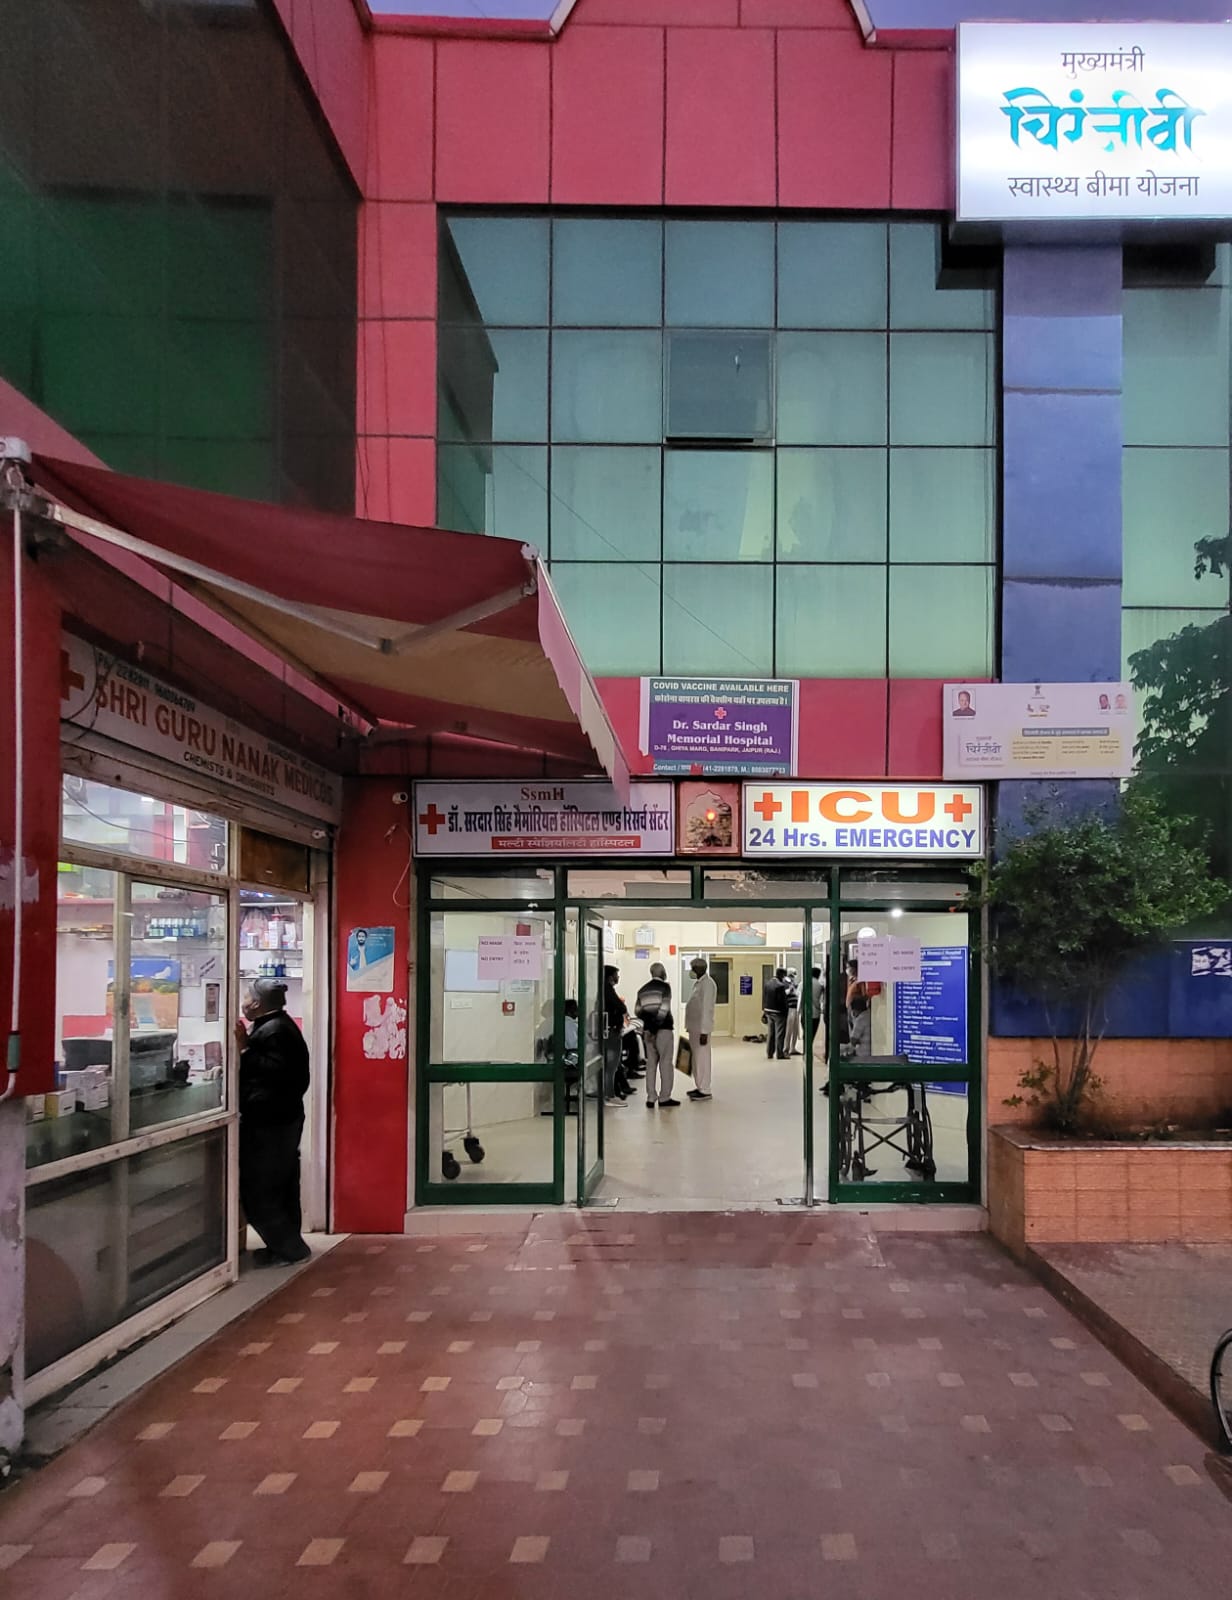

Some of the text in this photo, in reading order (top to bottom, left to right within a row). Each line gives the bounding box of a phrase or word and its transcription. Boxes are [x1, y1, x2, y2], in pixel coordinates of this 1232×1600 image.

[1061, 46, 1145, 79] मुख्यमंत्री
[1000, 86, 1208, 156] चिरंजीवी
[1008, 169, 1200, 197] स्वास्थ्य बीमा योजना
[653, 681, 789, 693] COVID VACCINE AVAILABLE HERE
[96, 675, 147, 726] SHRI
[154, 704, 216, 756] GURU
[222, 733, 280, 785] NANAK
[667, 734, 773, 747] Memorial Hospital
[672, 720, 768, 733] Dr. Sardar Singh
[183, 750, 225, 777] CHEMISTS
[226, 769, 233, 779] &
[653, 763, 676, 771] Contact
[520, 787, 565, 801] SsmH
[791, 790, 936, 824] ICU
[448, 804, 462, 832] डॉ.
[464, 811, 492, 832] सरदार
[494, 804, 512, 832] सिंह
[558, 804, 600, 832] हॉस्पिटल
[601, 810, 621, 832] एण्ड
[749, 828, 976, 848] 24 Hrs. EMERGENCY
